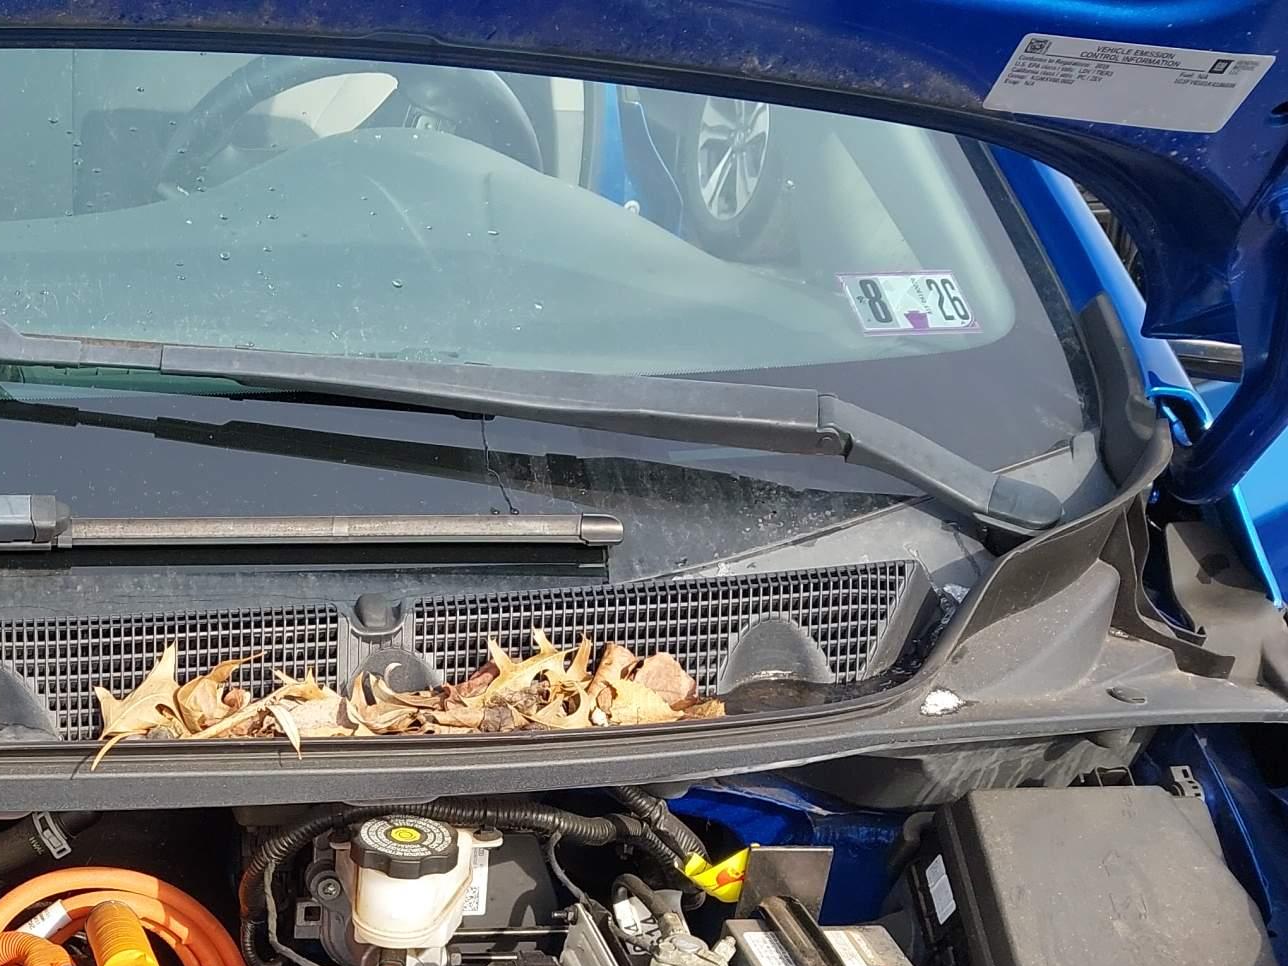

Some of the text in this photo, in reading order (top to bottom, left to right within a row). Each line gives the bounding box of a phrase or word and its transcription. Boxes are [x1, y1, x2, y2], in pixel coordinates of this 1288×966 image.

[1080, 51, 1181, 67] CONTROL INFORMATION
[1097, 46, 1175, 59] VEHICLE EMISSION
[859, 279, 893, 323] 8
[926, 278, 970, 321] 26
